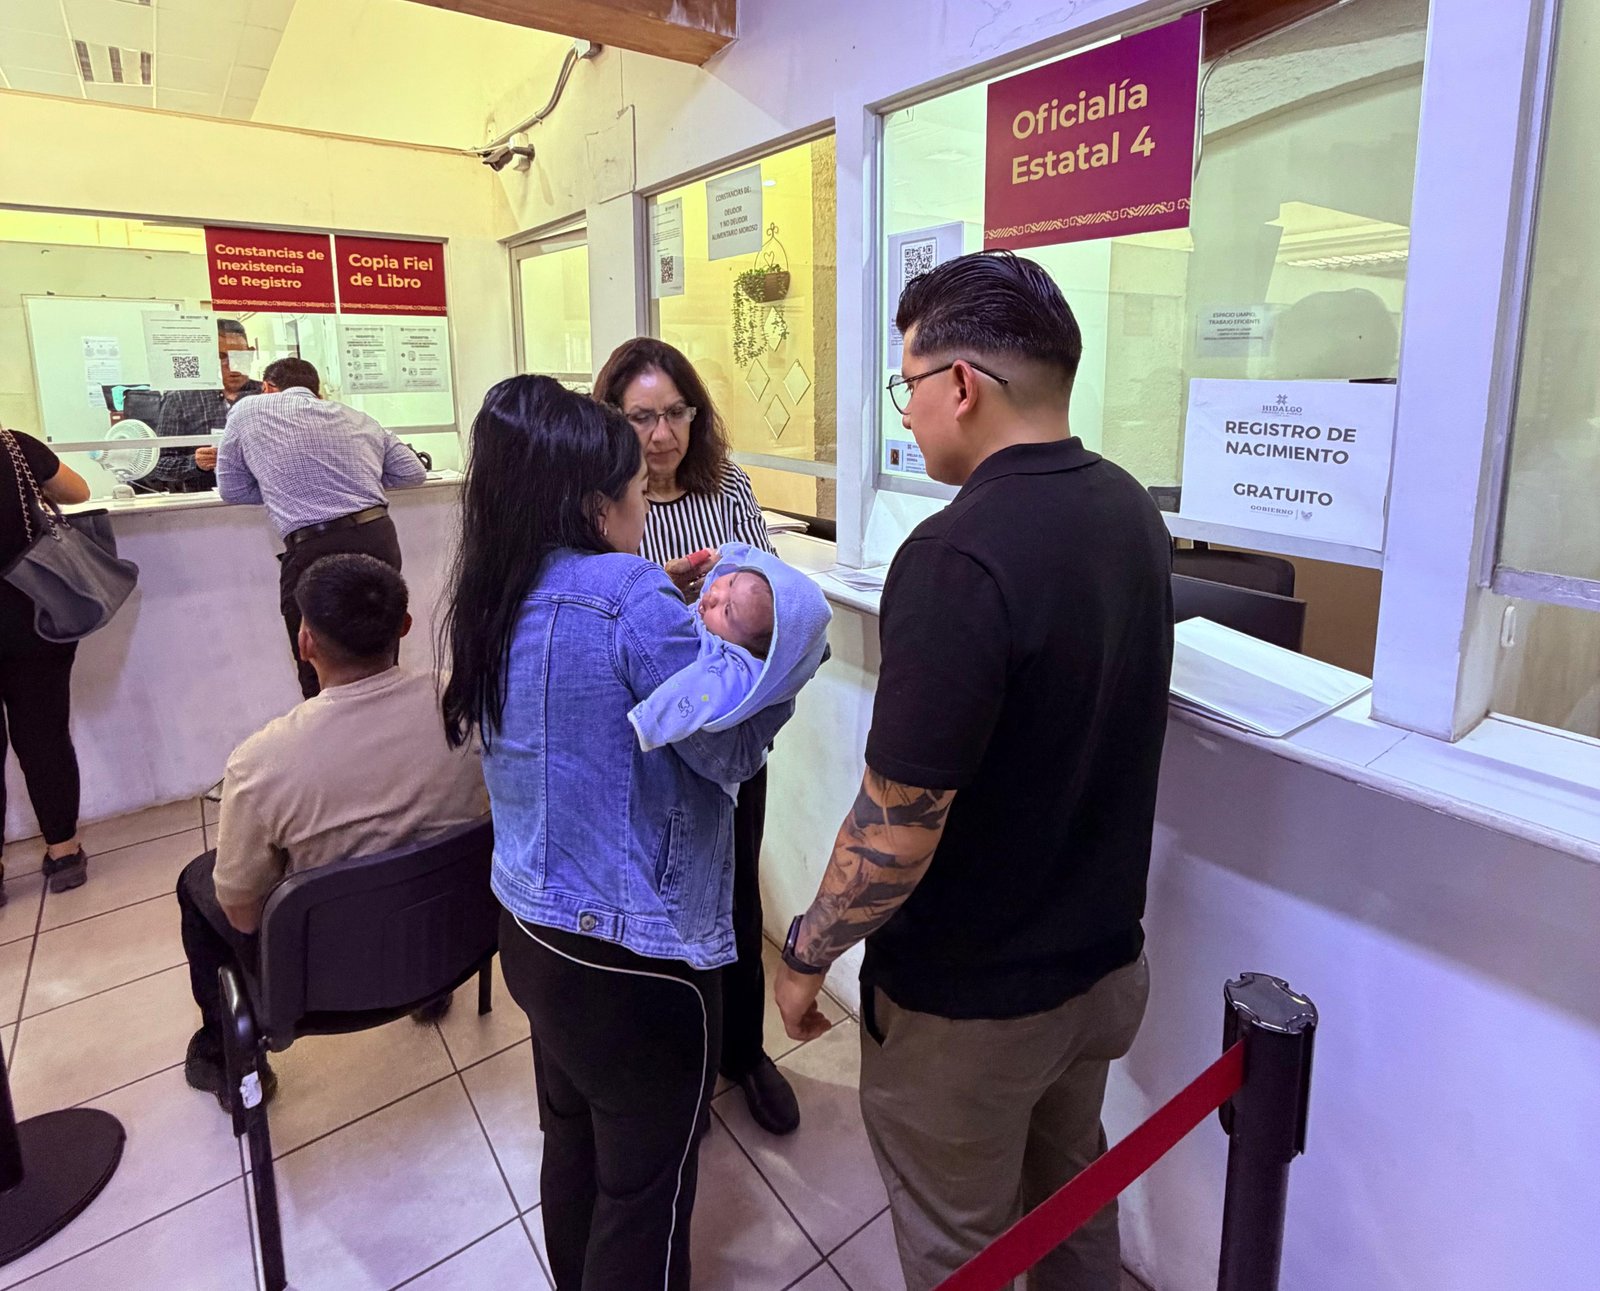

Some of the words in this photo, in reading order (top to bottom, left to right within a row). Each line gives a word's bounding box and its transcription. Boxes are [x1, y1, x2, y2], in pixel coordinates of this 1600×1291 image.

[1012, 78, 1148, 140] Oficialía
[1012, 131, 1120, 185] Estatal
[1130, 125, 1156, 158] 4
[716, 187, 743, 202] CONSTANCIAS
[724, 206, 742, 216] DEUDOR
[730, 215, 748, 226] DEUDOR
[712, 228, 738, 241] ALIMENTARIO
[738, 224, 758, 235] MOROSO
[215, 244, 304, 259] Constancias
[306, 249, 325, 261] de
[217, 259, 304, 274] Inexistencia
[349, 253, 399, 270] Copia
[403, 256, 433, 271] Fiel
[218, 274, 237, 286] de
[241, 275, 302, 290] Registro
[350, 273, 373, 286] de
[378, 274, 421, 289] Libro
[1262, 405, 1303, 413] HIDALGO
[1225, 420, 1321, 440] REGISTRO
[1327, 427, 1357, 443] DE
[1225, 441, 1349, 465] NACIMIENTO
[1233, 483, 1333, 506] GRATUITO
[1250, 505, 1294, 515] GOBIERNO
